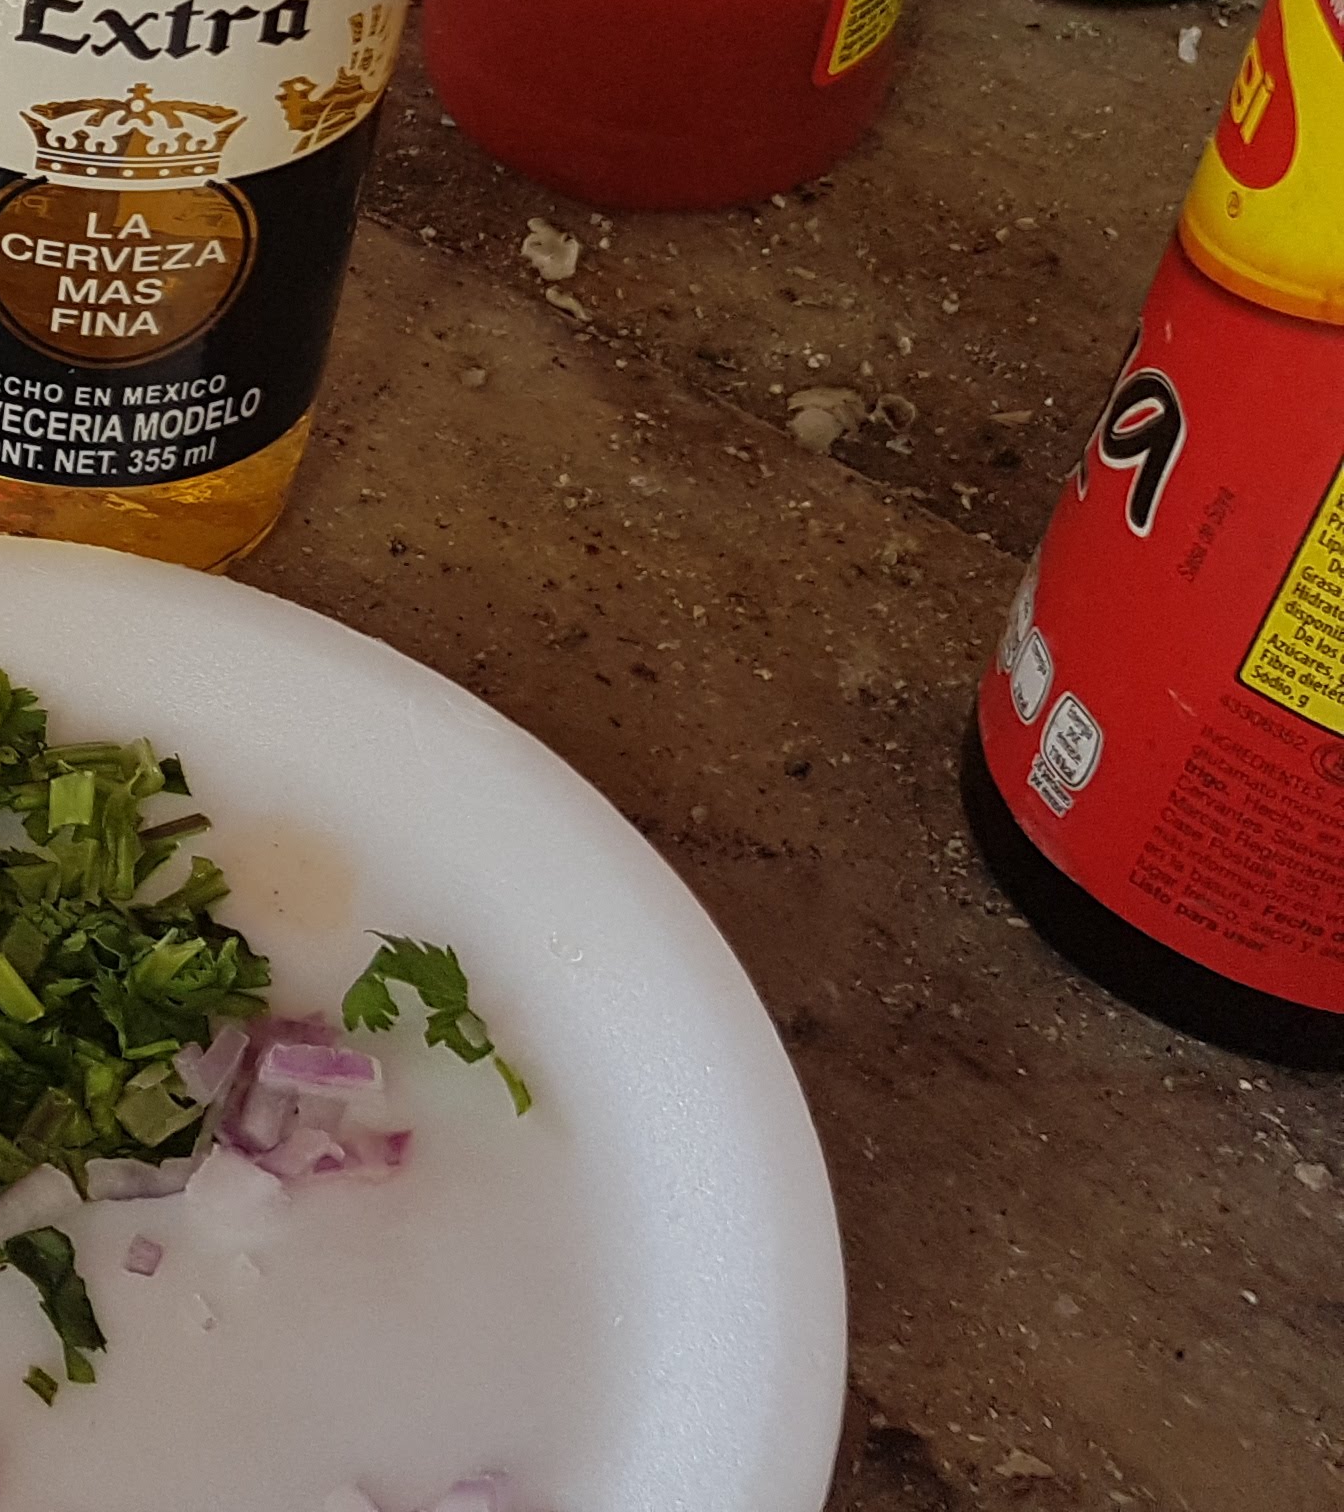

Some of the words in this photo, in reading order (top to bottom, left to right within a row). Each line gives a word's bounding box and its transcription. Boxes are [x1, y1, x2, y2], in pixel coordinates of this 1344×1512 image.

[86, 211, 152, 239] LA
[0, 233, 227, 273] CERVEZA
[57, 275, 164, 305] MAS
[49, 307, 160, 337] FINA
[74, 386, 113, 407] EN
[122, 374, 227, 407] MEXICO
[132, 387, 262, 443] MODELO
[54, 449, 118, 475] NET.
[127, 448, 179, 474] 355
[183, 436, 217, 468] ml
[1301, 565, 1343, 599] Grasa
[1293, 625, 1315, 647] De
[1315, 637, 1339, 660] los
[1261, 648, 1297, 680] Fibra
[1173, 901, 1220, 933] para
[1261, 903, 1325, 938] Fecha
